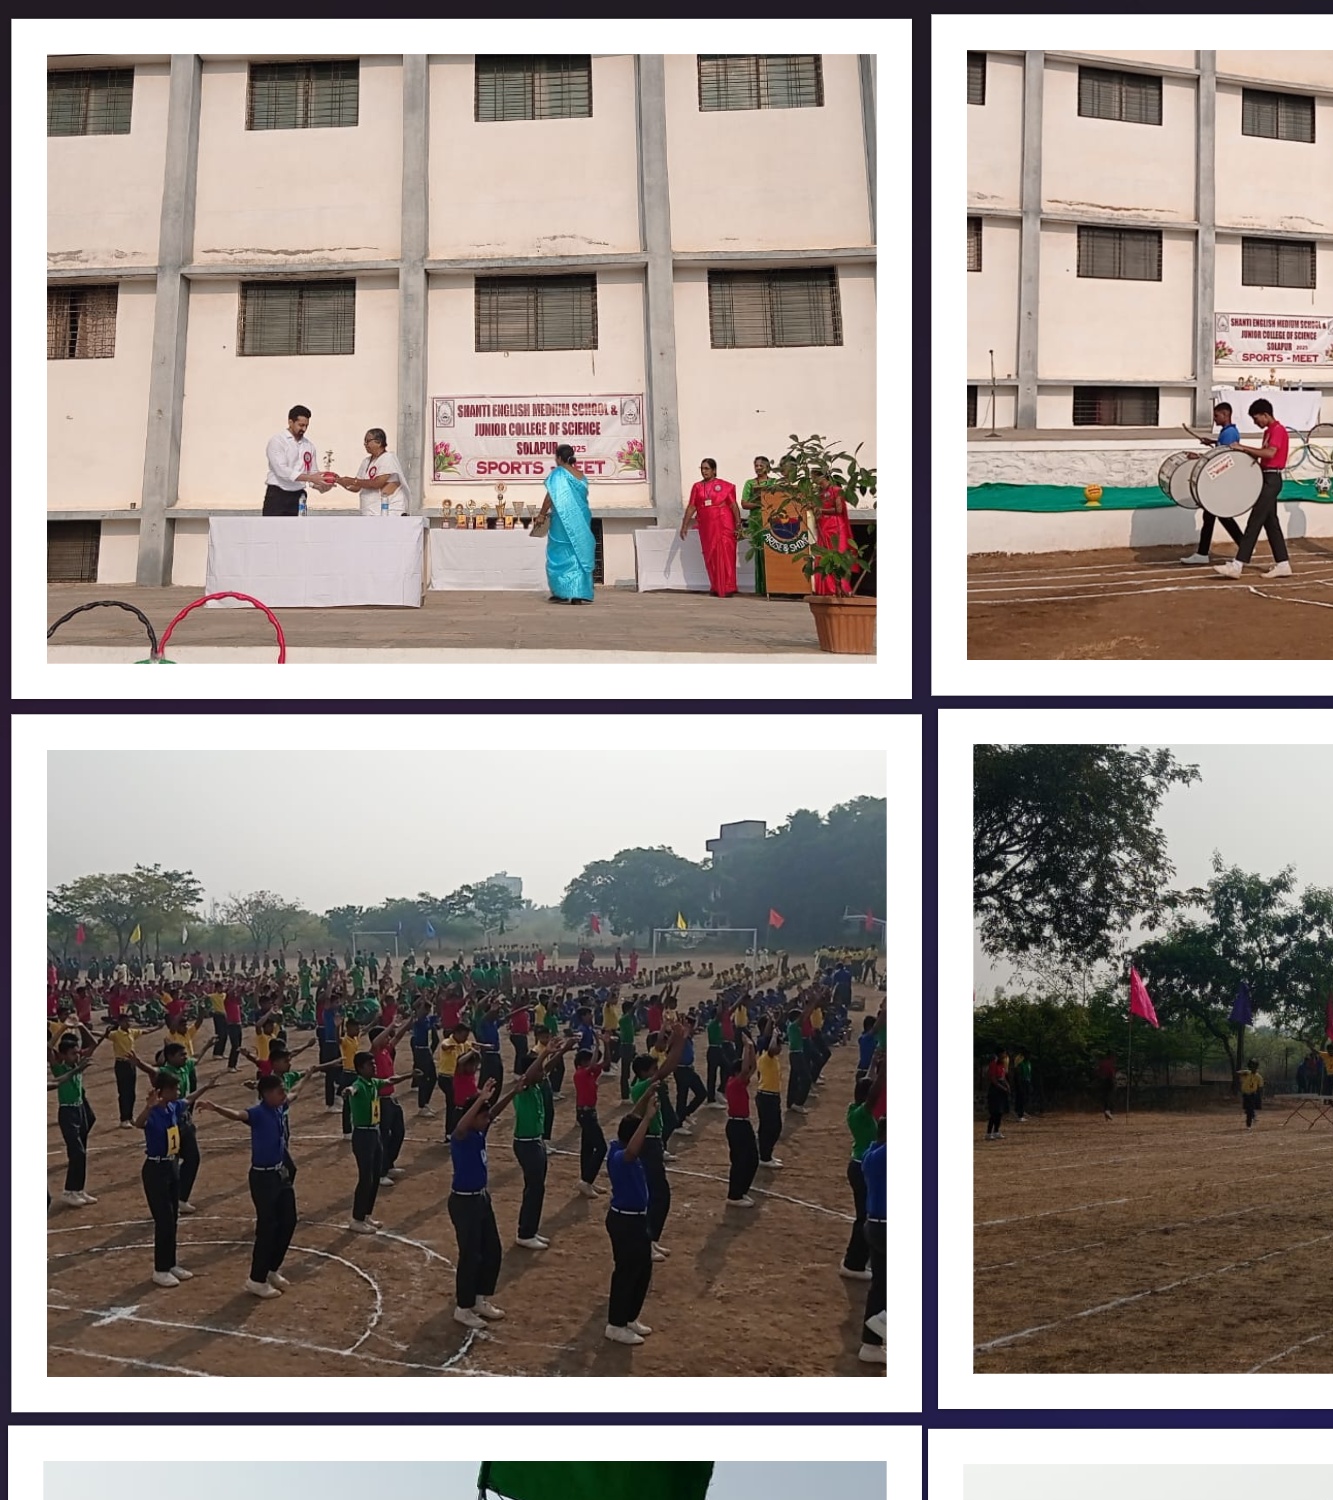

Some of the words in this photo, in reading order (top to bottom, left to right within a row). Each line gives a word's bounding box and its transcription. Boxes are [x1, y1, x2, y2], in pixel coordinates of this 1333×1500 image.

[1230, 317, 1251, 328] SHANTI
[1252, 318, 1276, 328] ENGLISH
[1277, 319, 1299, 329] MEDIUM
[1300, 319, 1321, 330] SCHOOL
[1241, 330, 1262, 339] JUNIOR
[1262, 330, 1285, 340] COLLEGE
[1286, 331, 1293, 340] OF
[1294, 331, 1317, 340] SCIENCE
[1266, 342, 1292, 351] SOLAPUR
[1242, 353, 1283, 362] SPORTS
[1292, 354, 1319, 363] MEET
[457, 403, 491, 418] SHANTI
[492, 403, 531, 417] ENGLISH
[533, 402, 569, 416] MEDIUM
[572, 402, 608, 416] SCHOOL
[610, 404, 618, 416] &
[474, 422, 506, 437] JUNIOR
[508, 422, 547, 436] COLLEGE
[549, 422, 560, 436] OF
[561, 421, 601, 435] SCIENCE
[516, 441, 558, 456] SOLAPUR
[476, 461, 544, 475] SPORTS
[575, 460, 606, 475] EET
[763, 533, 784, 551] ARISE
[171, 1134, 177, 1150] 1
